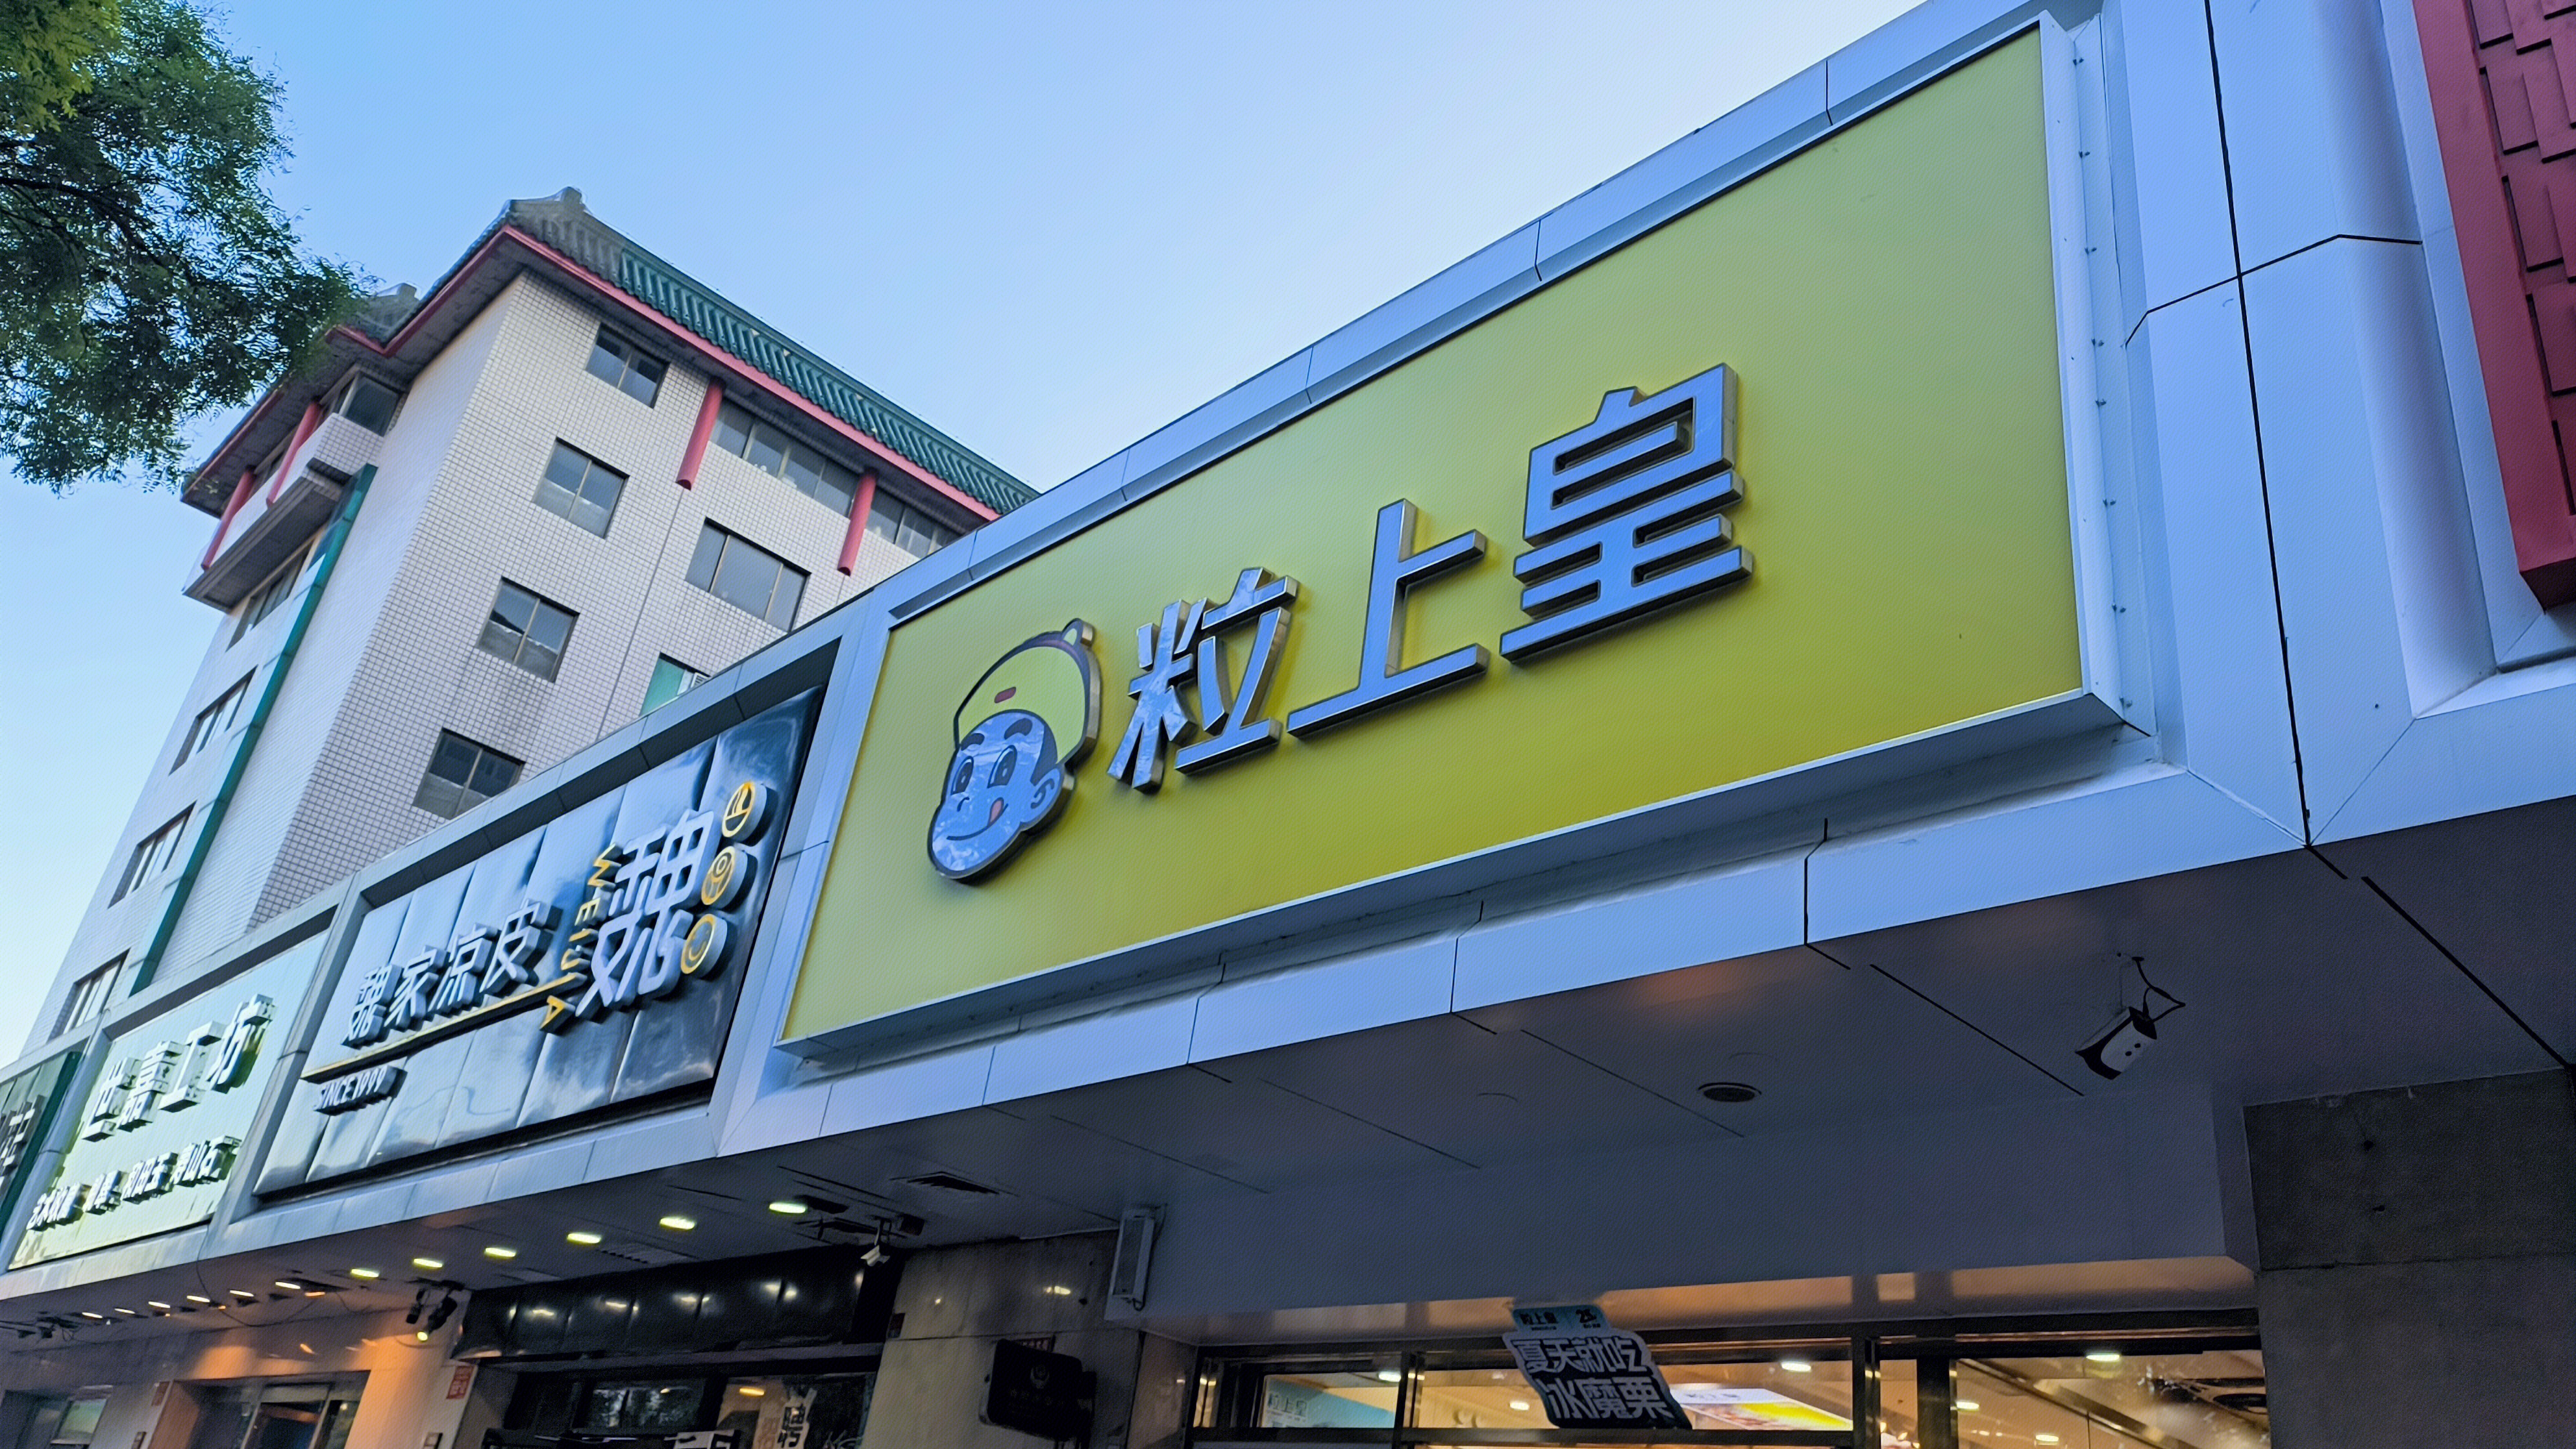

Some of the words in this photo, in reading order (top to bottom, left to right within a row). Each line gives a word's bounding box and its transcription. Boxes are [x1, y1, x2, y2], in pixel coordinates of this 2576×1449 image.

[1107, 361, 1754, 795] 粒上皇
[341, 898, 549, 1046] 魏家凉皮
[312, 1075, 361, 1111] SINCE
[352, 1064, 391, 1101] 1999
[121, 1151, 175, 1201] 和田玉
[1511, 1335, 1648, 1374] 夏天就吃
[1533, 1376, 1676, 1420] 冰魔栗
